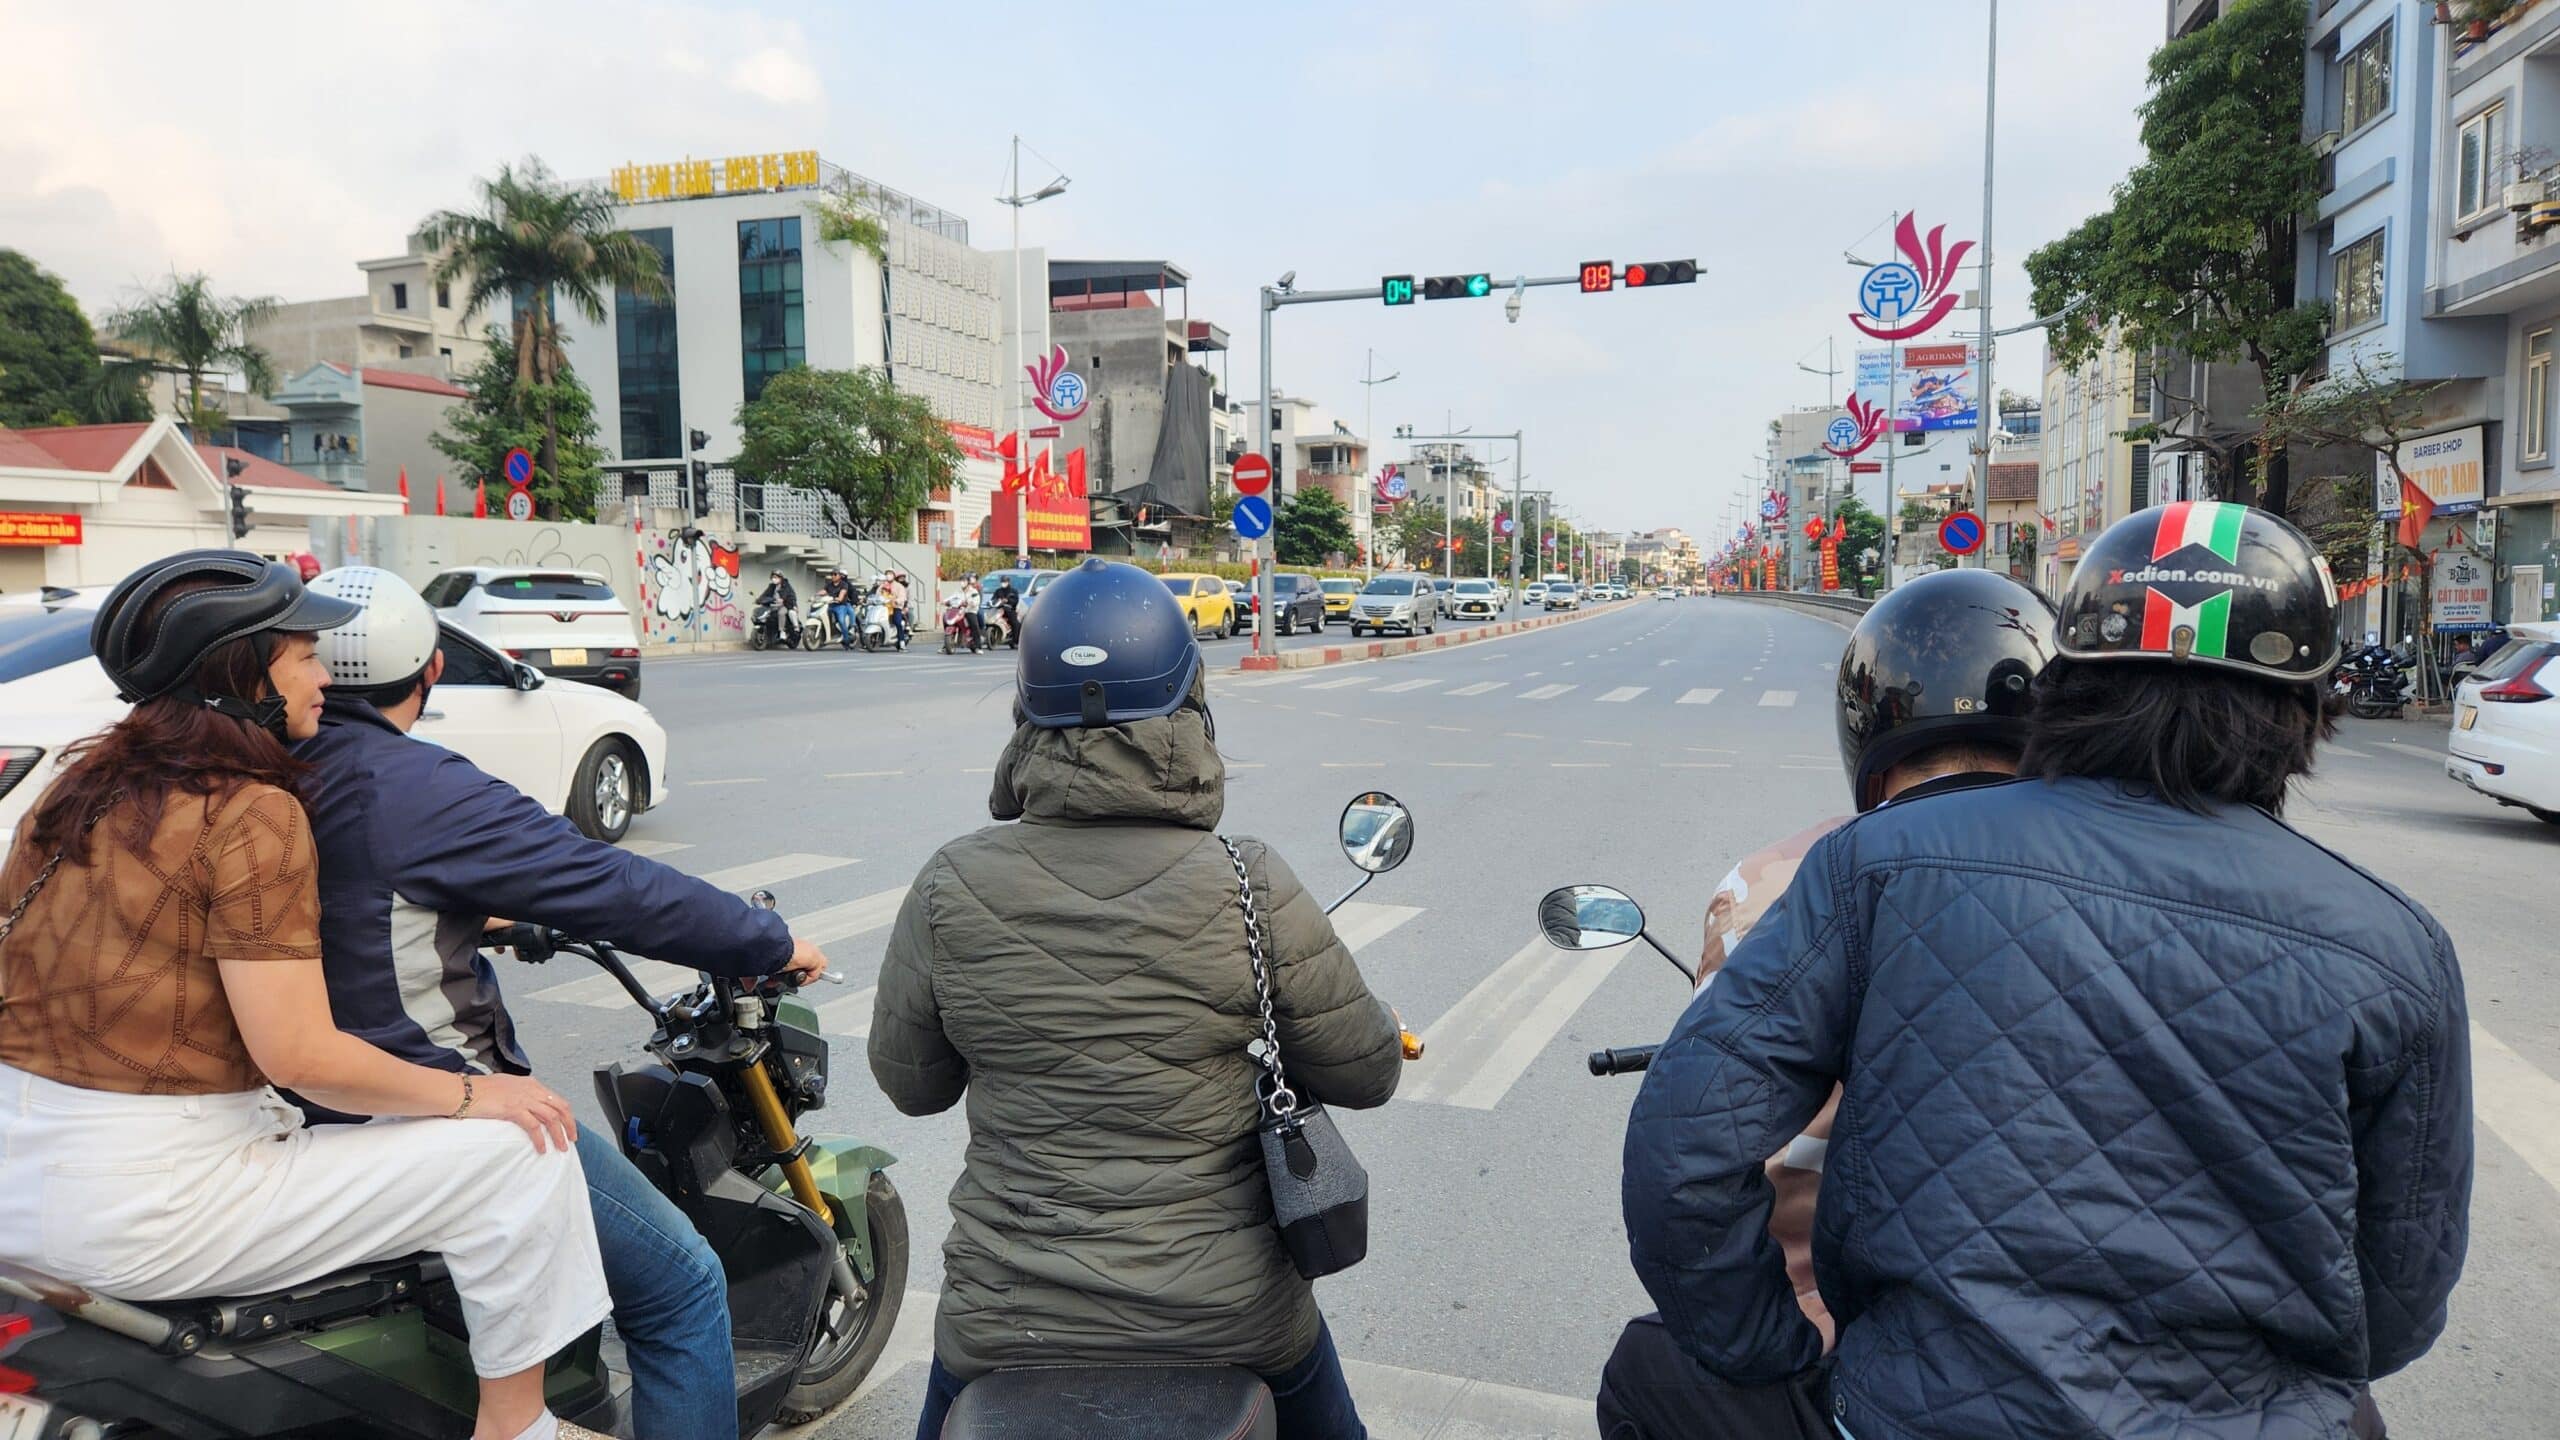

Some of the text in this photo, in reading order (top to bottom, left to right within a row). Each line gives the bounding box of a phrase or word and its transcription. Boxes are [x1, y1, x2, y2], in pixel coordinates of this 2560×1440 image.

[675, 154, 713, 196] SÁNG
[1584, 264, 1610, 290] 09
[1387, 278, 1412, 303] 04
[1915, 350, 1965, 362] AGRIBANK
[2414, 438, 2463, 459] BARBER SHOP
[2425, 462, 2448, 497] TÓC
[2451, 460, 2479, 496] NAM
[2471, 587, 2488, 603] NAM
